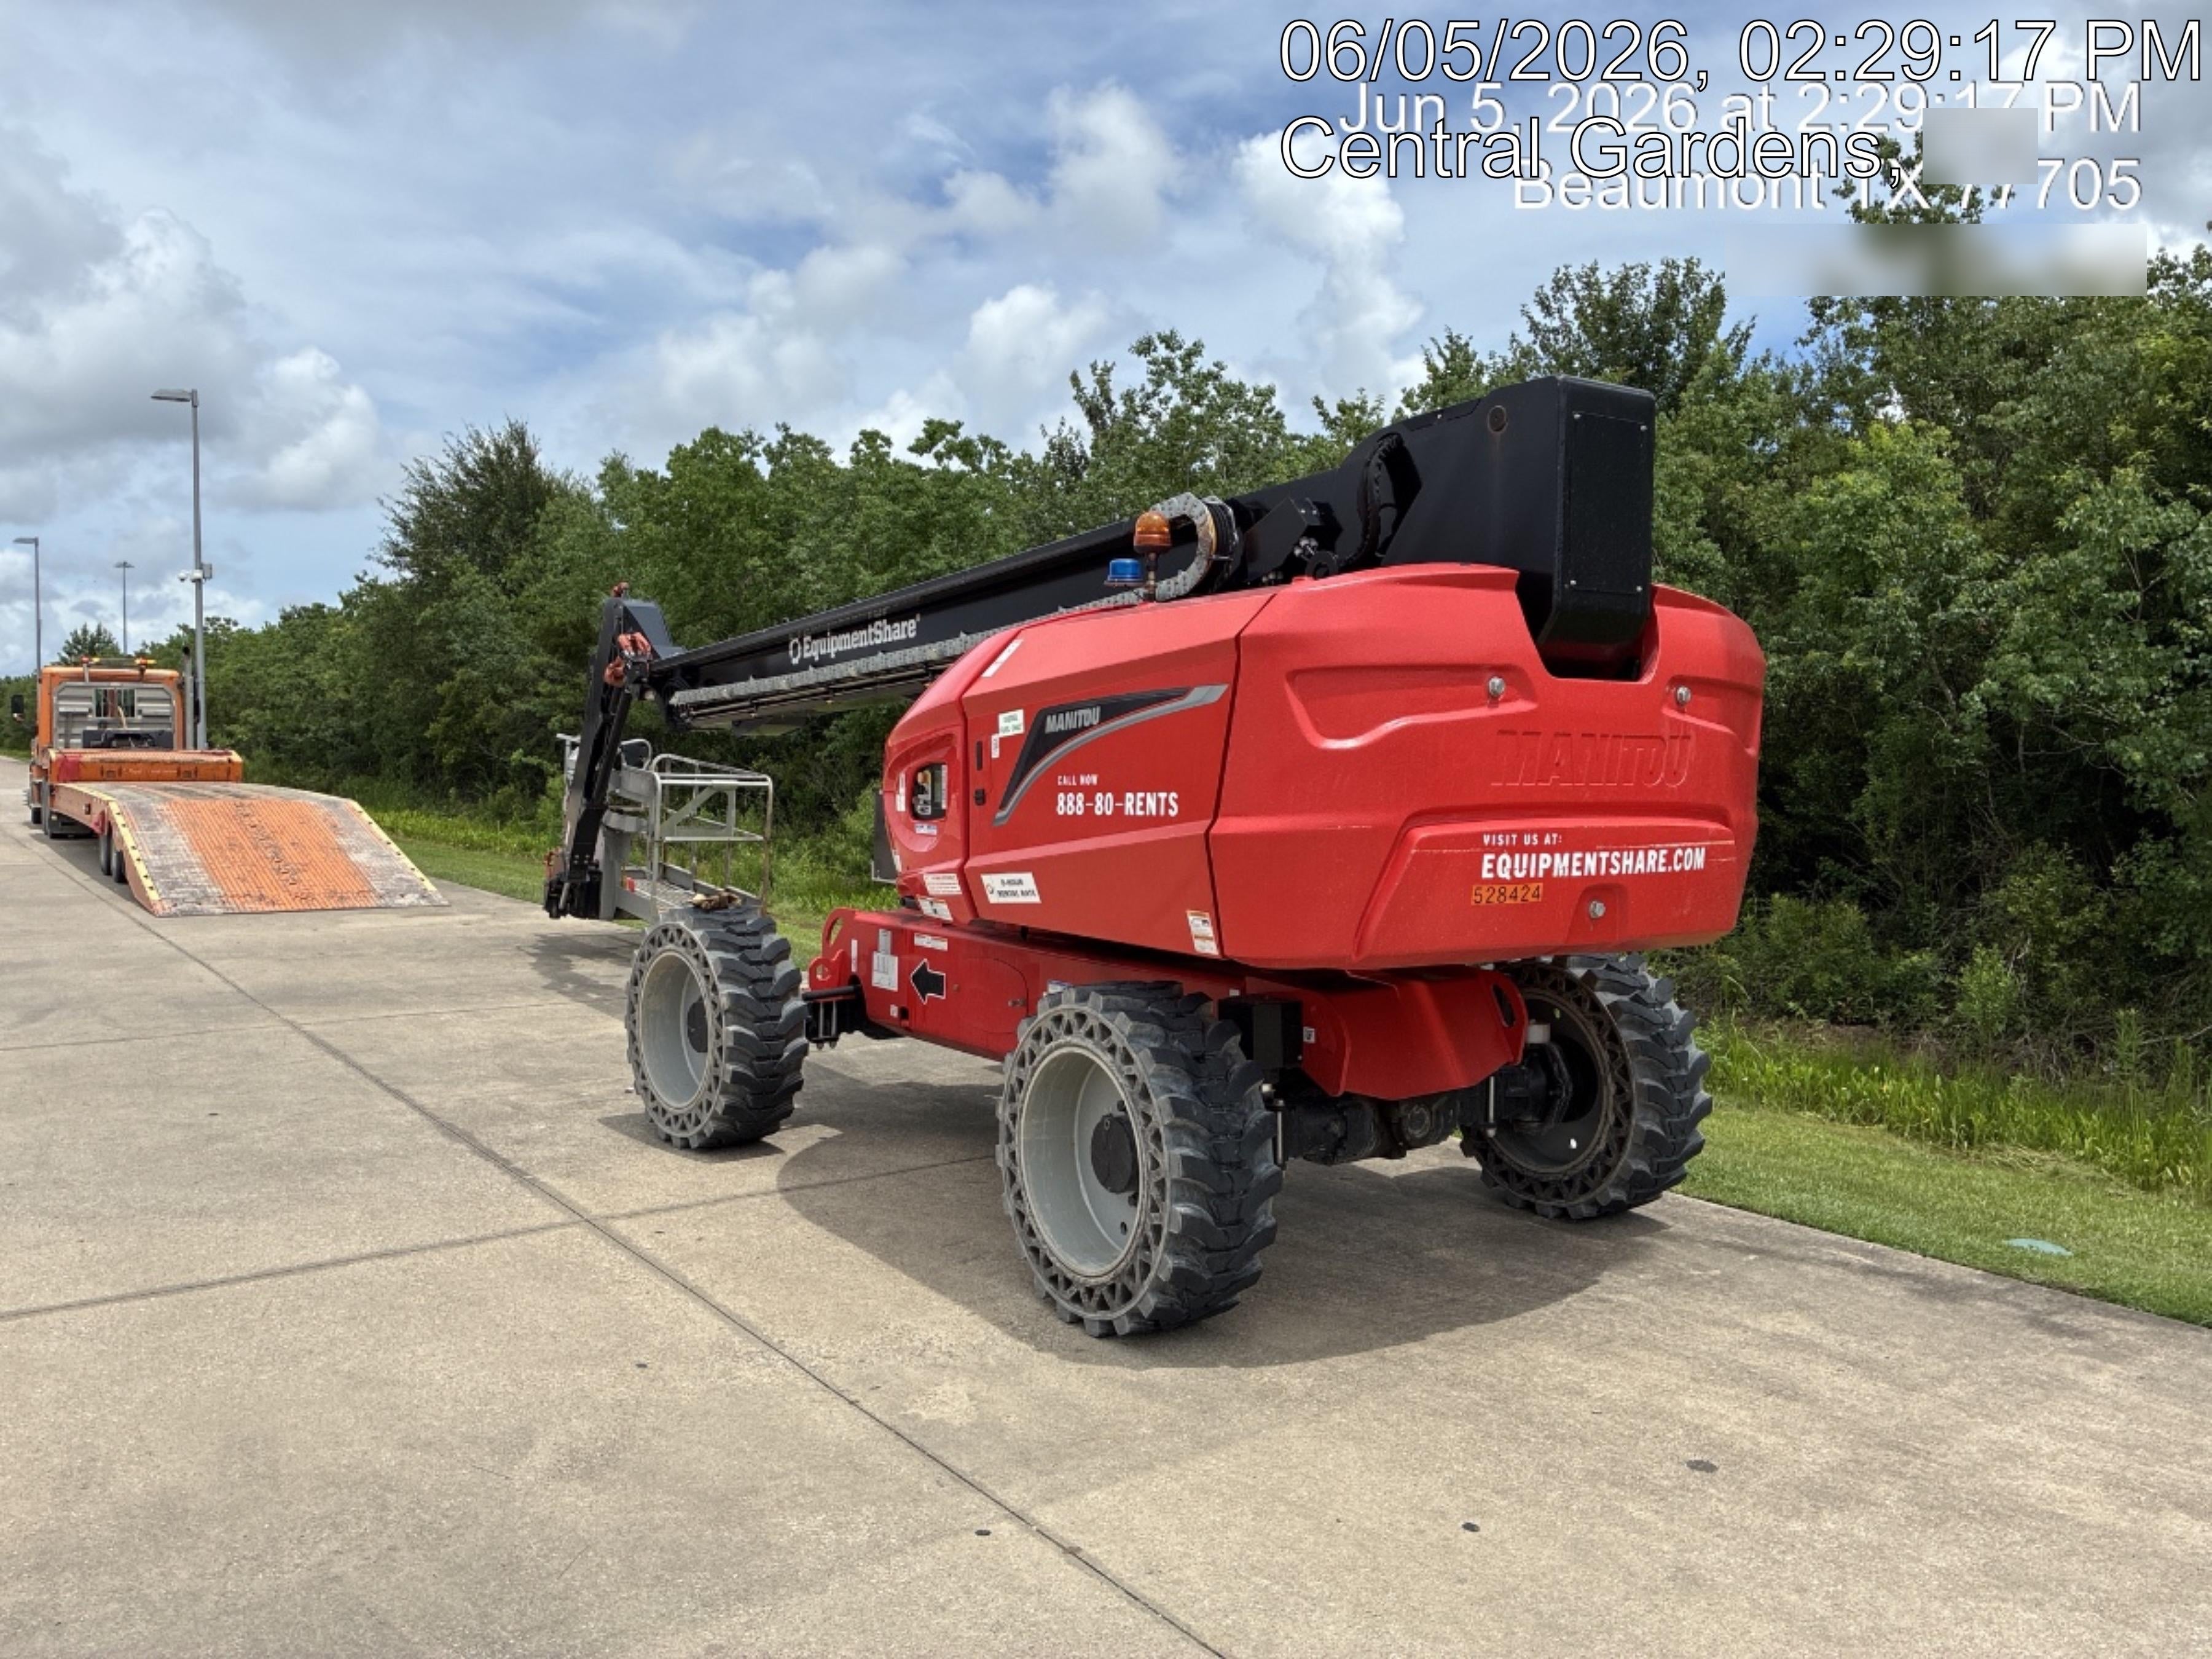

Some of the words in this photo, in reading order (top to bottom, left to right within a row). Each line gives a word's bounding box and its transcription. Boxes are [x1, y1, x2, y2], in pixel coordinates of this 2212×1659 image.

[803, 618, 917, 661] EquipmentShare
[1045, 705, 1102, 734] MANITOU
[1491, 730, 1693, 787] MANITOU
[1057, 775, 1077, 786] CALL
[1080, 774, 1099, 786] NOW
[1056, 791, 1179, 817] 888-80-RENTS
[1483, 833, 1516, 845] VISIT
[1523, 833, 1539, 845] US
[1544, 833, 1563, 845] AT:
[1481, 847, 1706, 880] EQUIPMENTSHARE.COM
[1473, 885, 1541, 904] 528424
